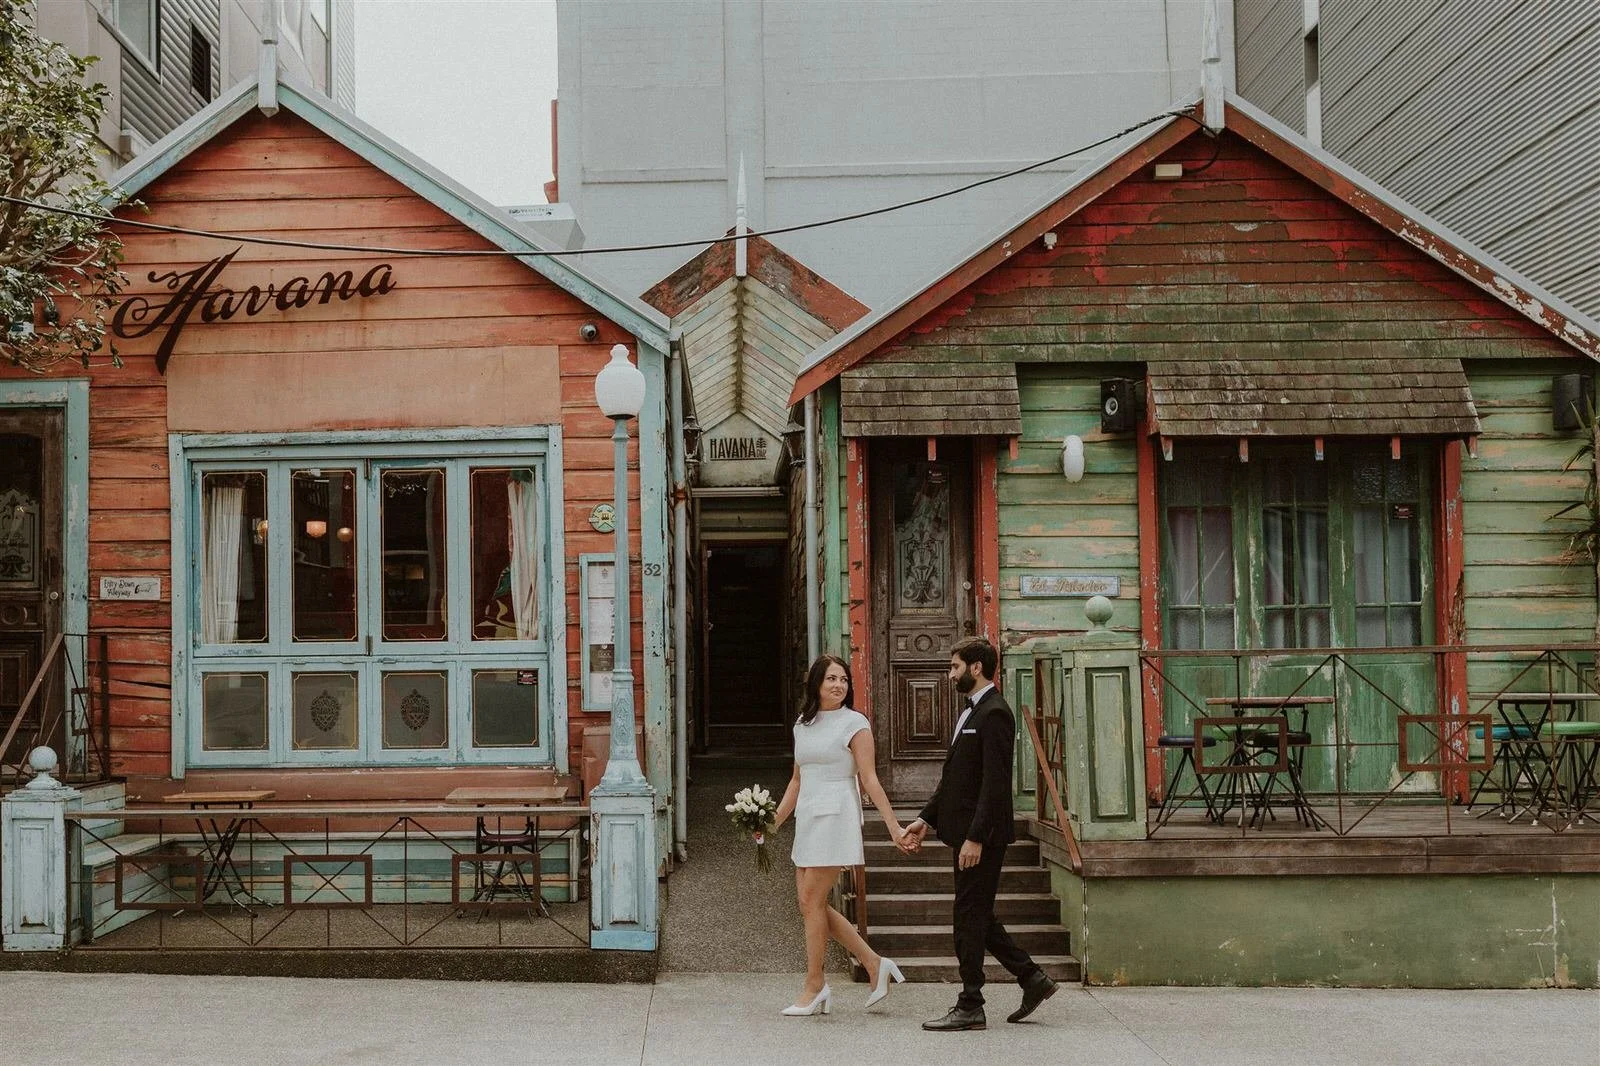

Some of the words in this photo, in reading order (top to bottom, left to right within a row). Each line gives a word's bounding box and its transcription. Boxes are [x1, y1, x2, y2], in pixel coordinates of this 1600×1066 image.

[112, 244, 397, 376] Havana
[709, 437, 756, 458] HAVANA
[644, 562, 661, 576] 32
